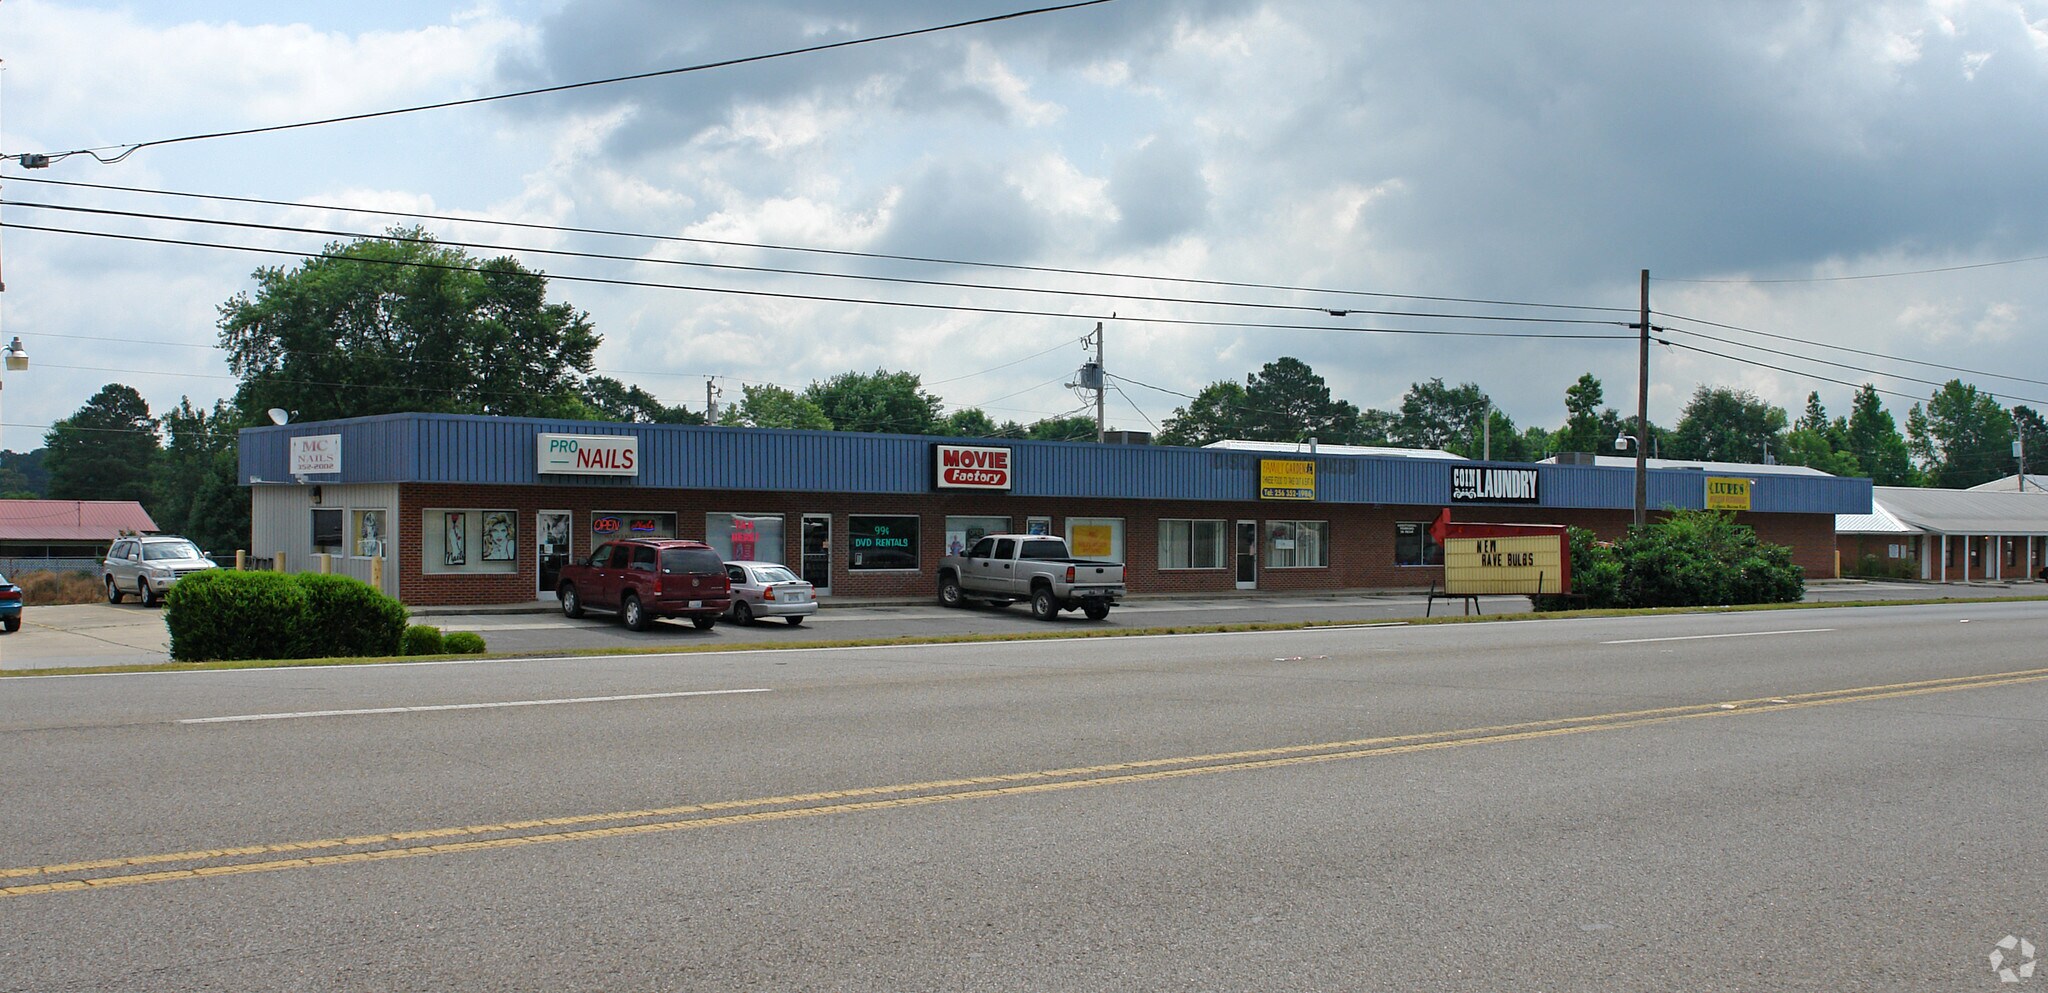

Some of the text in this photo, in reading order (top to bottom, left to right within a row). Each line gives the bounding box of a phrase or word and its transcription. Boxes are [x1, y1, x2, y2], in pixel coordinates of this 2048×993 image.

[303, 440, 328, 453] MC
[550, 439, 578, 453] PRO
[298, 455, 334, 463] NAILS
[577, 448, 634, 469] NAILS
[943, 449, 1008, 469] MOVIE
[1263, 462, 1285, 474] FAMILY
[1286, 462, 1307, 475] GARDEN
[952, 470, 1002, 484] Factory
[1453, 468, 1537, 499] COIN LAUNDRY
[593, 519, 620, 531] OPEN
[855, 538, 909, 547] DVD RENTALS
[1507, 552, 1534, 567] BULBS
